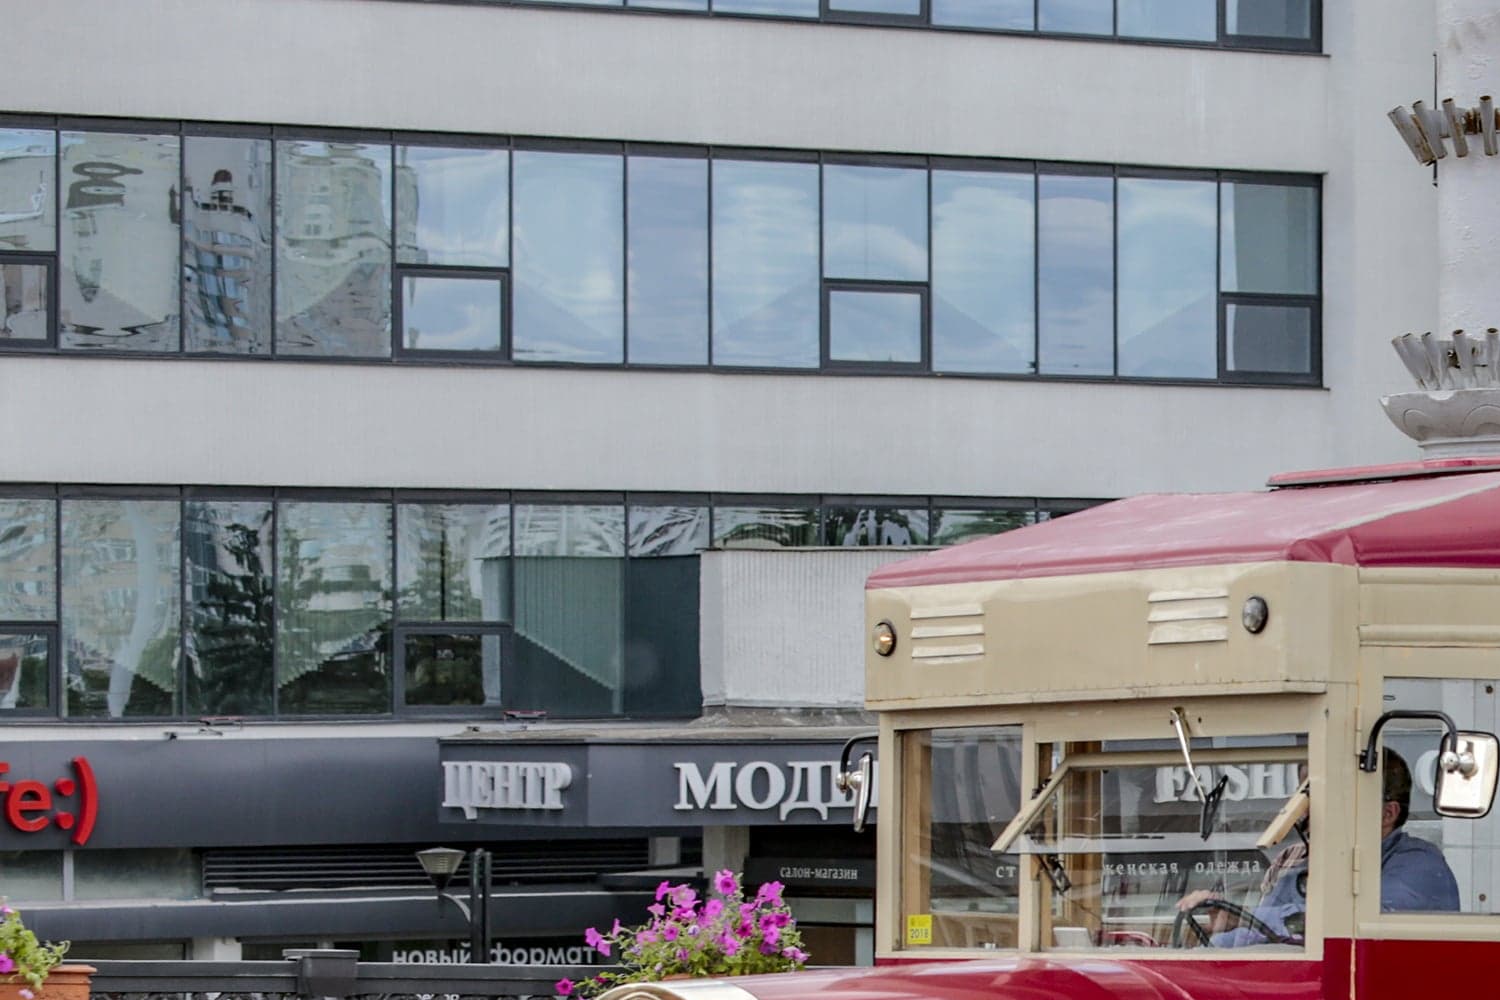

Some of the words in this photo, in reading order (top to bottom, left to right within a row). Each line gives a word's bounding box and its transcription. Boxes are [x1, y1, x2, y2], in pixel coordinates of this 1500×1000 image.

[442, 760, 572, 820] ЦЕНТР
[780, 866, 858, 880] салон-магазин
[1195, 859, 1261, 875] одежда
